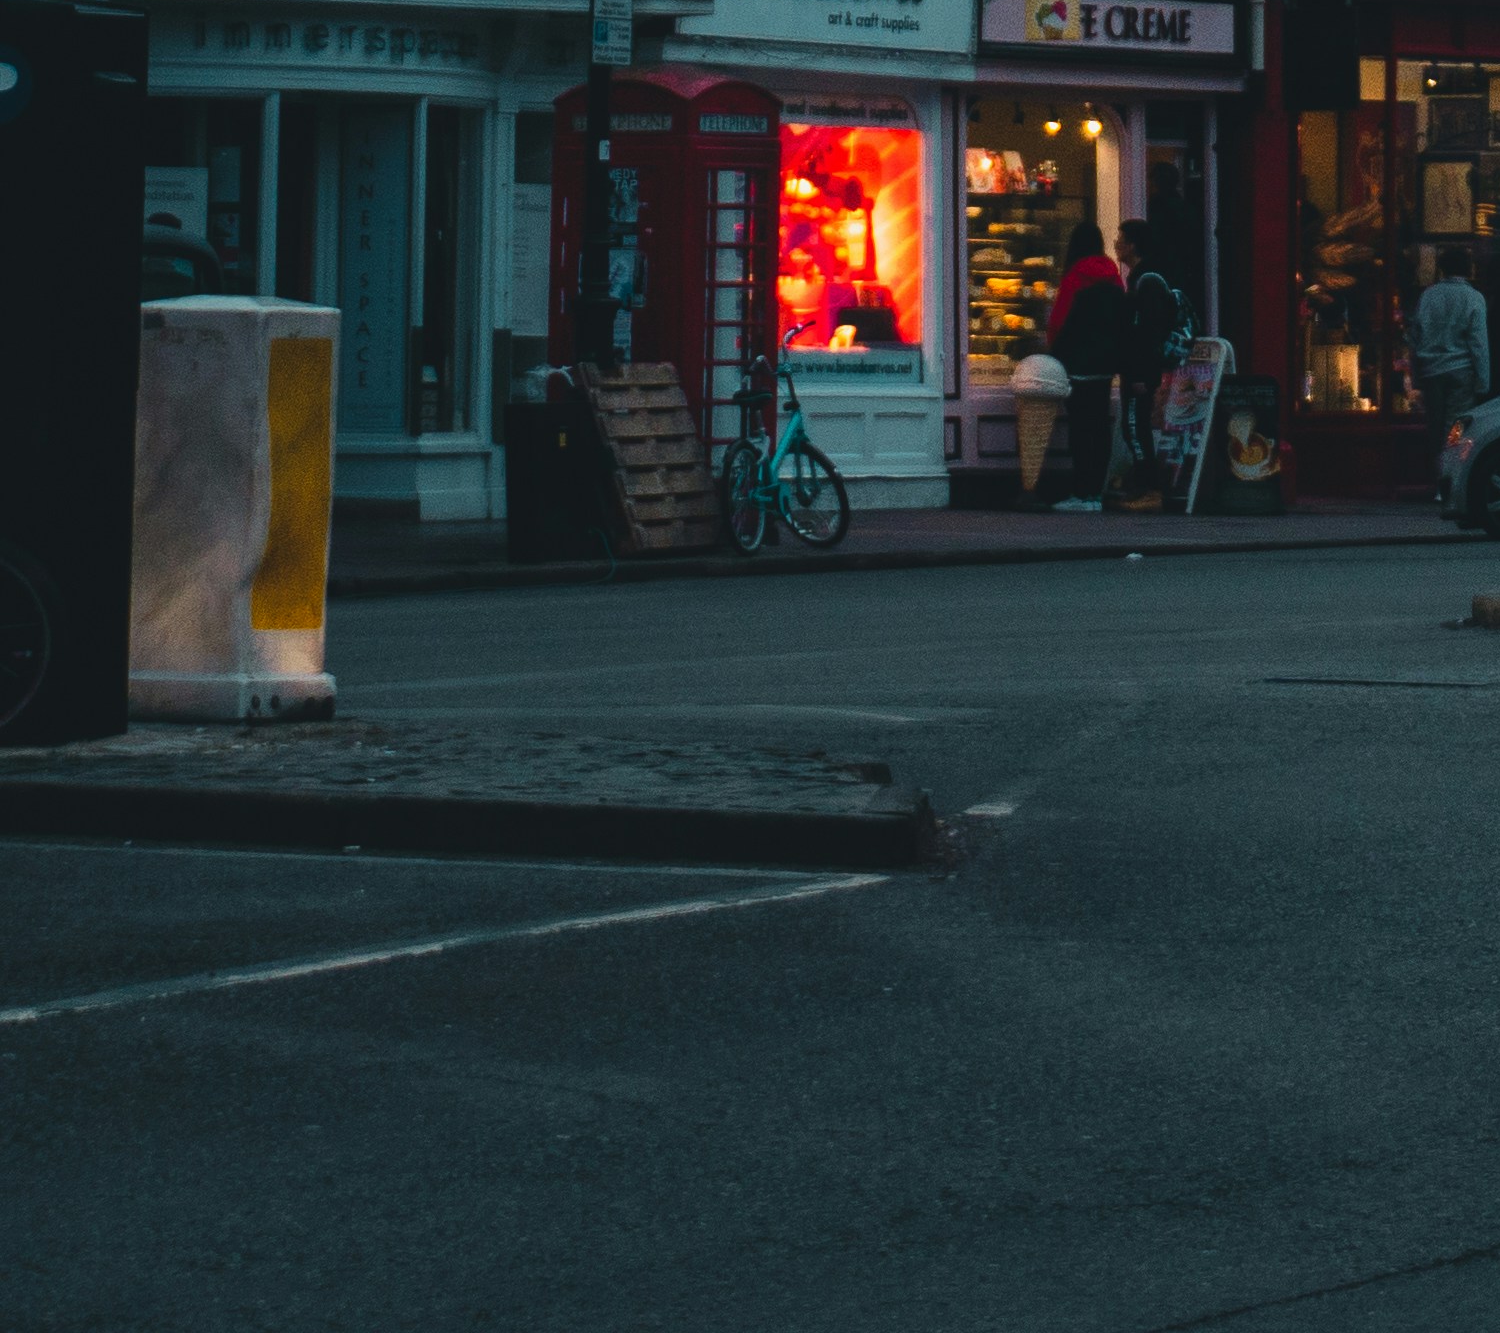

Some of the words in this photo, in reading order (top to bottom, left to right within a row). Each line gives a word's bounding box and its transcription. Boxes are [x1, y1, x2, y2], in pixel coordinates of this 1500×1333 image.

[828, 13, 843, 26] art
[845, 12, 853, 26] &
[856, 13, 879, 28] craft
[881, 14, 920, 33] supplies
[869, 104, 908, 123] supplies
[700, 116, 767, 132] TELEPHONE
[357, 271, 372, 389] SPACE
